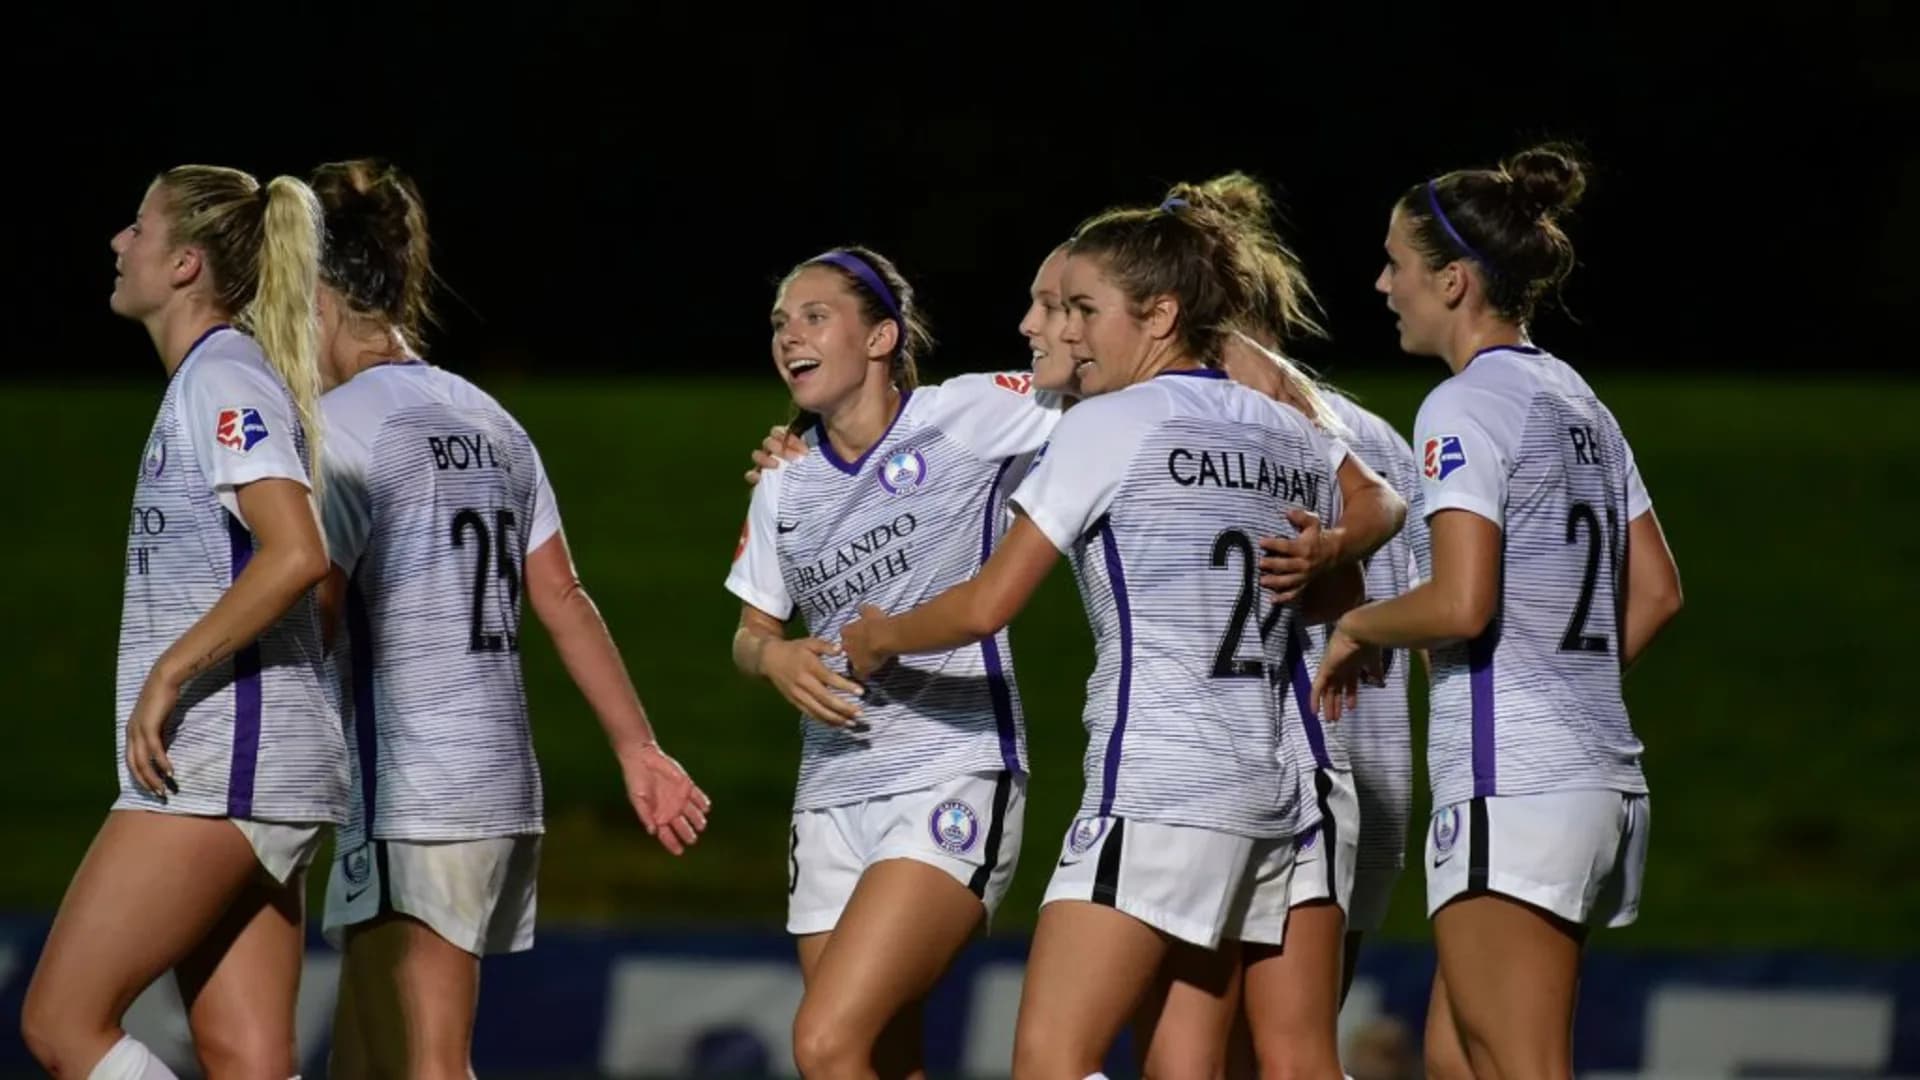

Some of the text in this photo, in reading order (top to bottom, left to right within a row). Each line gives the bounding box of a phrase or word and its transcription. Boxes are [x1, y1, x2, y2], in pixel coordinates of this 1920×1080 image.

[427, 433, 508, 473] BOYL
[1569, 426, 1600, 465] RE
[1168, 448, 1320, 512] CALLAHAN
[791, 513, 917, 594] ORLANDO
[806, 549, 913, 618] HEALTH
